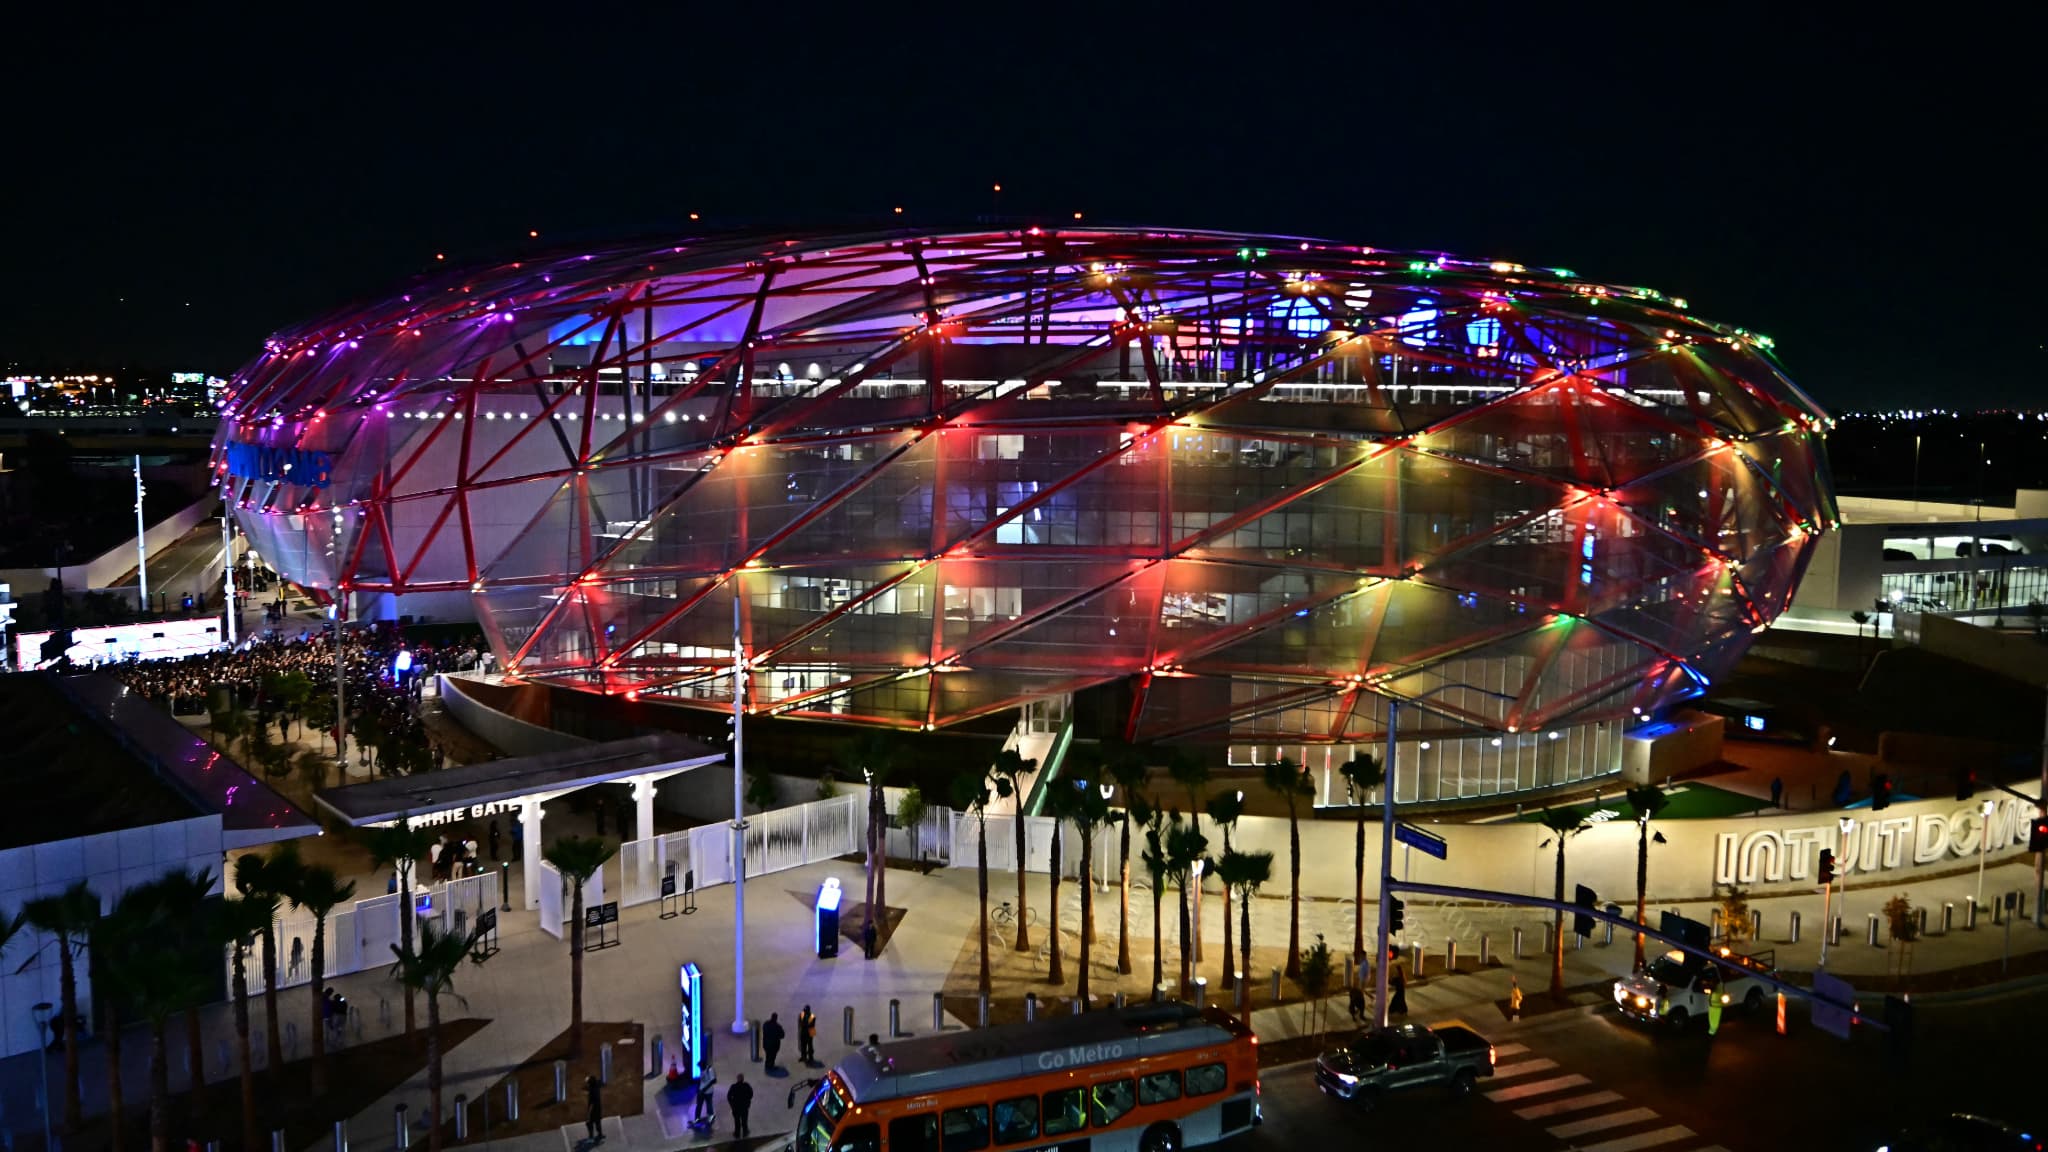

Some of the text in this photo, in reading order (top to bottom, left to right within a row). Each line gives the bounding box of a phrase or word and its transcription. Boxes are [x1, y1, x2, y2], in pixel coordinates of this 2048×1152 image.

[471, 800, 520, 819] GATE
[1716, 816, 1914, 884] INTUIT
[1038, 1044, 1123, 1070] Go Metro
